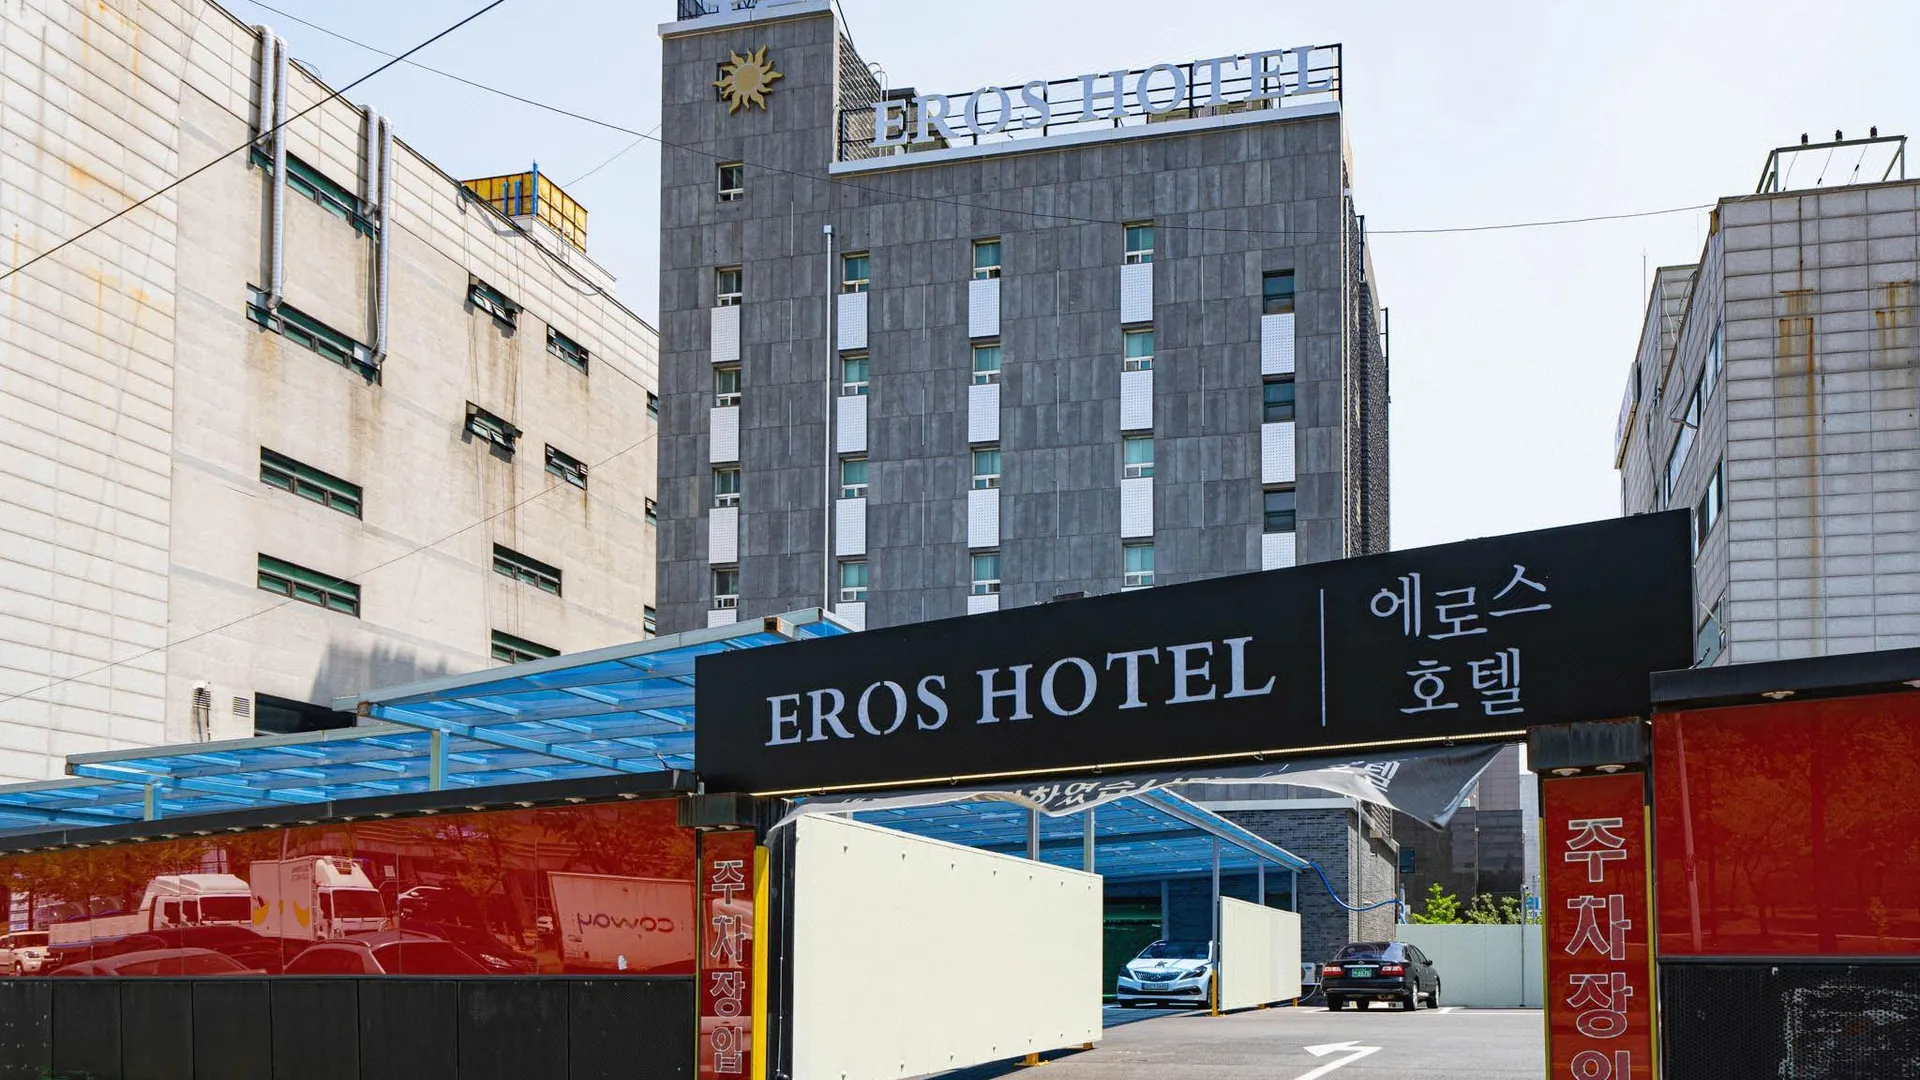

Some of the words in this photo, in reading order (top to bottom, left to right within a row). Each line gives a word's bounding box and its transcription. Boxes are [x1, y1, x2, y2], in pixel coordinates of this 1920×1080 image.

[872, 80, 1049, 148] EROS
[1077, 45, 1335, 121] HOTEL
[1369, 562, 1553, 641] 에로스
[764, 674, 949, 746] EROS
[975, 635, 1277, 725] HOTEL
[1400, 647, 1525, 716] 호텔
